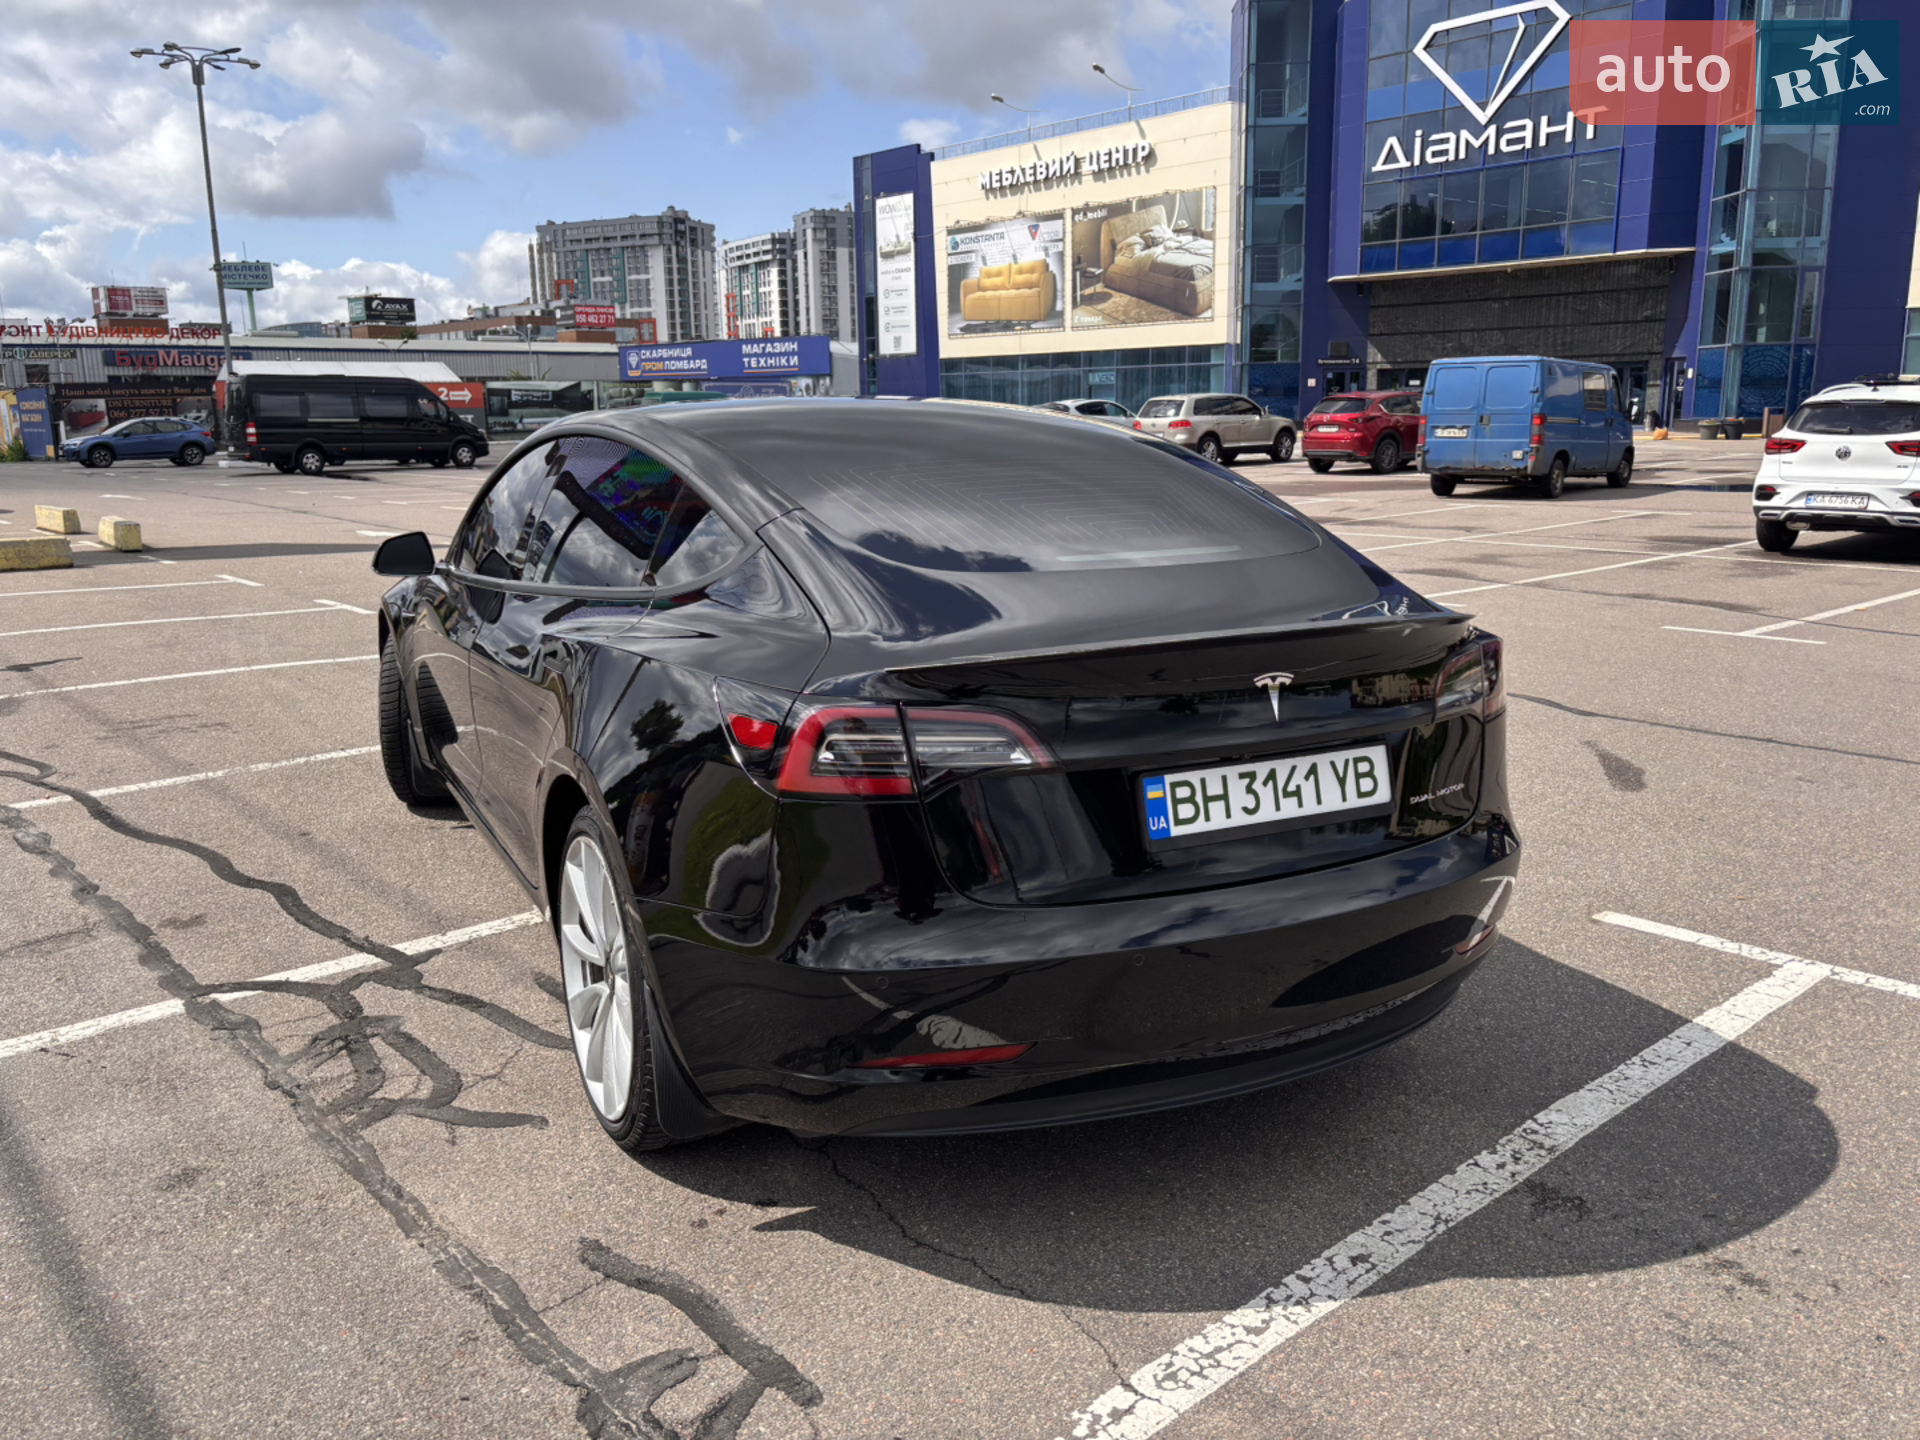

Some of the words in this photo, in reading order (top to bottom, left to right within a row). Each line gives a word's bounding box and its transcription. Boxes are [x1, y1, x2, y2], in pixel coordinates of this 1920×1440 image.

[978, 151, 1077, 190] МЕБЛЕВИЙ
[1085, 141, 1150, 172] ЦЕНТР
[960, 232, 1005, 246] KONSTANTA
[47, 325, 165, 340] БУДІВНИЦТВО
[170, 327, 222, 341] ДЕКОР
[641, 347, 692, 359] СКАРБНИЦЯ
[742, 341, 798, 354] МАГАЗИН
[743, 355, 799, 367] ТЕХНІКИ
[124, 399, 174, 407] FURNITURE
[1812, 494, 1826, 504] KA
[1169, 775, 1232, 827] BH
[1238, 762, 1323, 816] 3141
[1329, 755, 1379, 803] YB
[1149, 815, 1168, 831] UA
